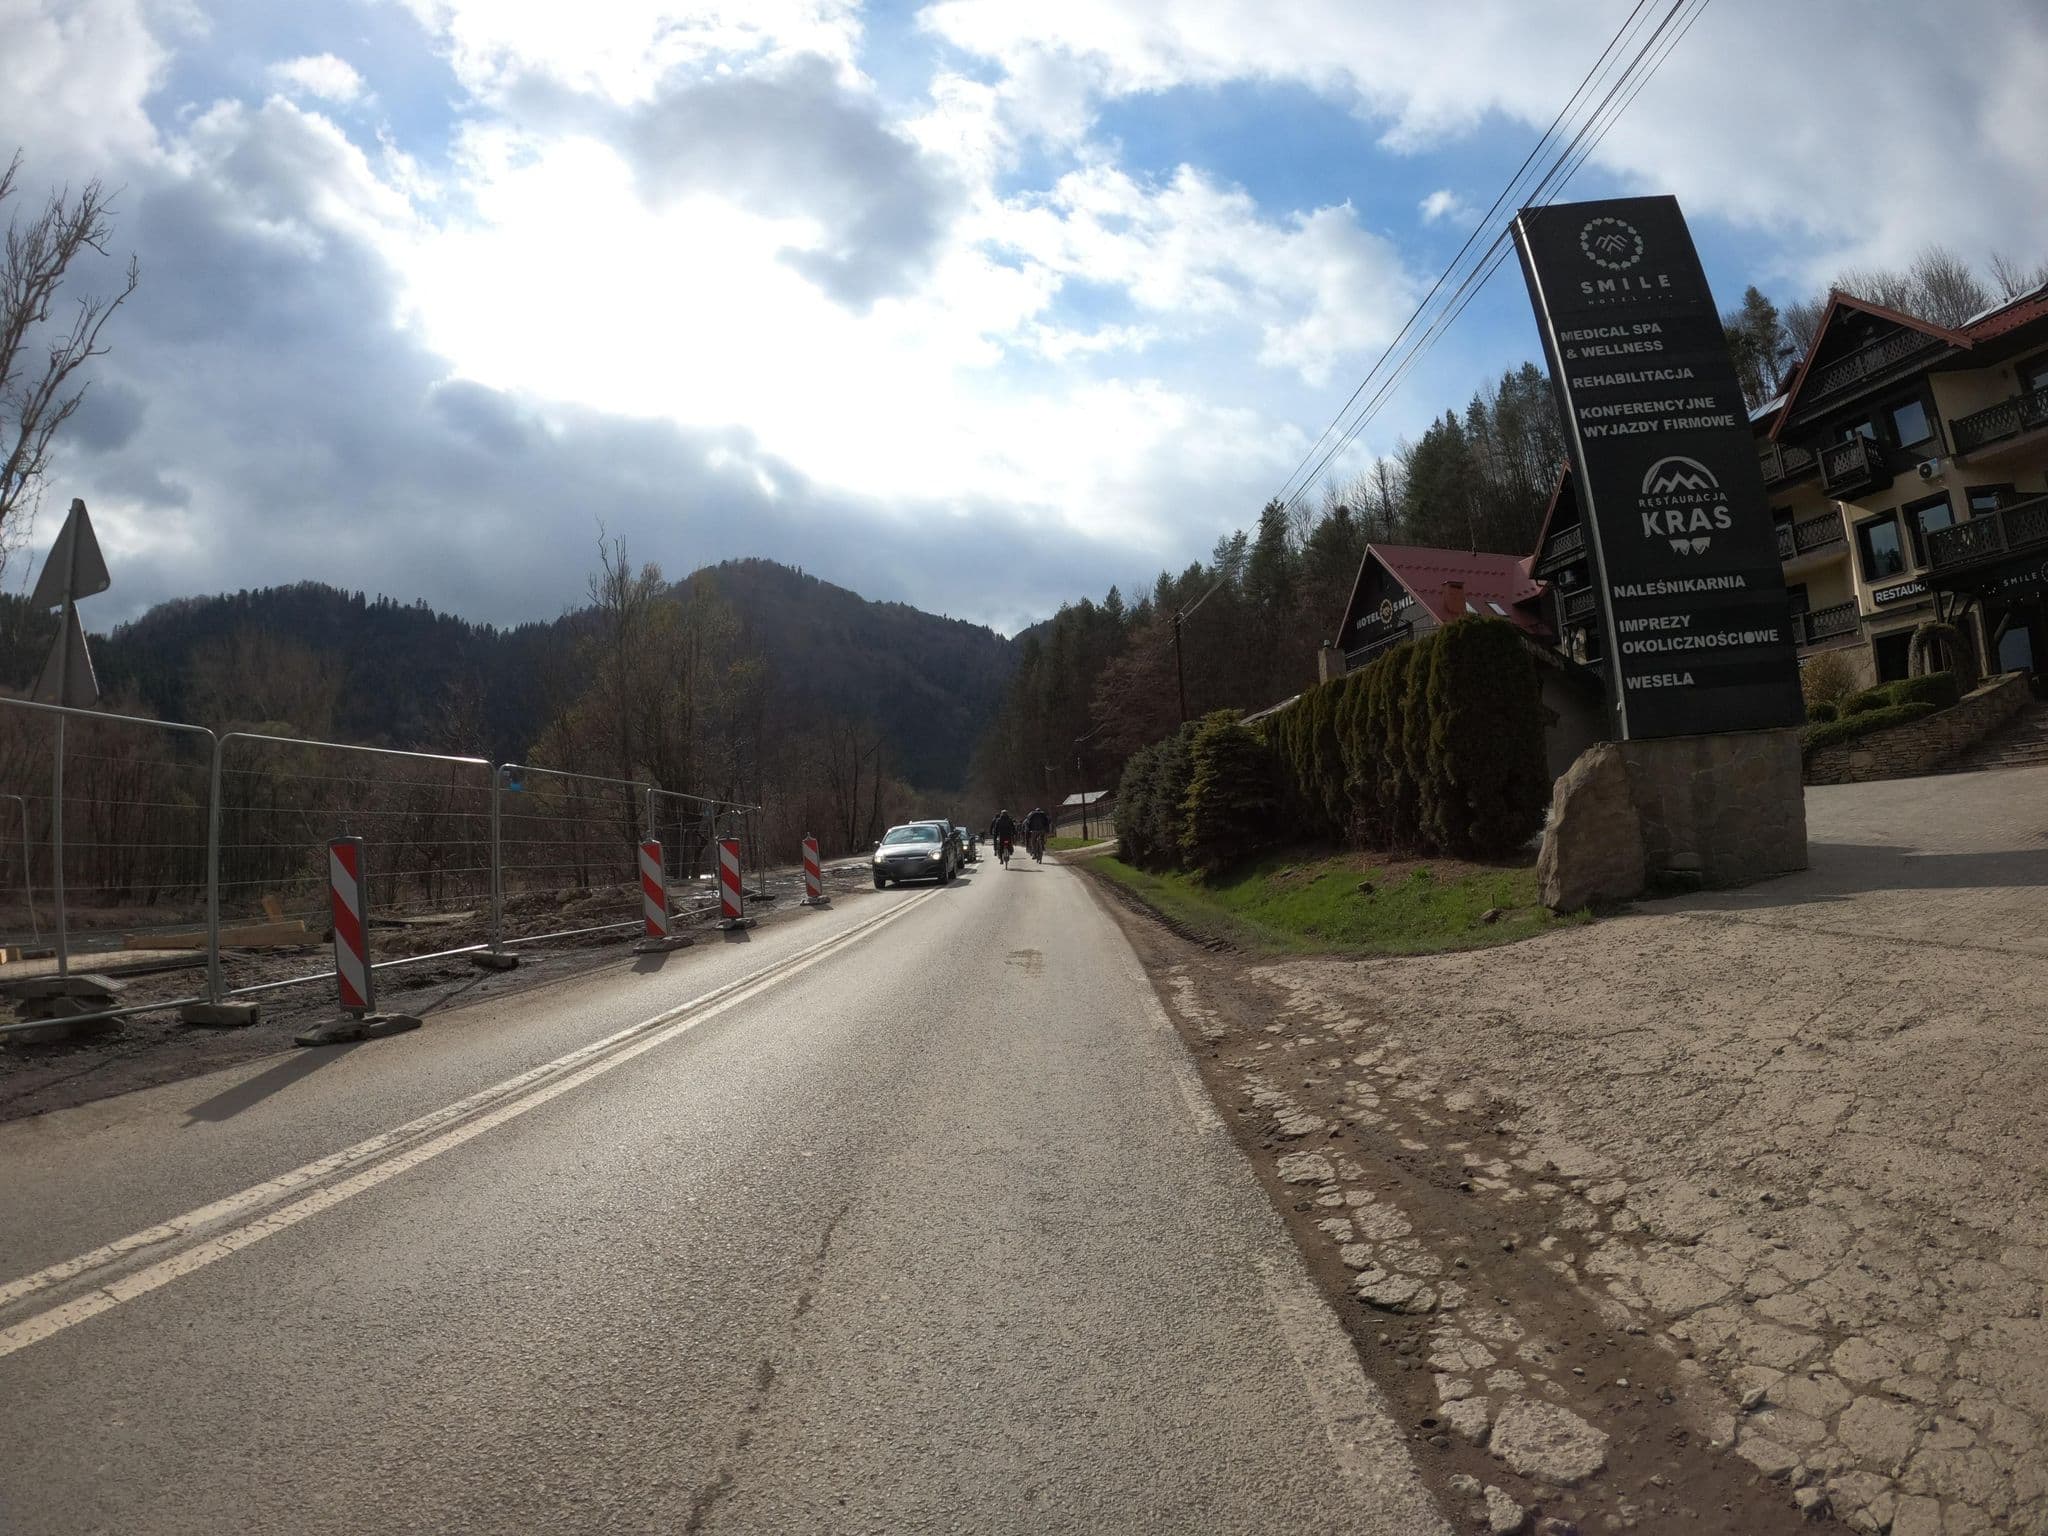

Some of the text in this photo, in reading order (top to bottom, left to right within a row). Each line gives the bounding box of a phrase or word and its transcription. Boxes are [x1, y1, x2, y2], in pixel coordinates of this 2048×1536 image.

[1580, 274, 1671, 294] SMILE
[1560, 323, 1663, 342] MEDICAL SPA
[1566, 340, 1664, 359] & WELLNESS
[1573, 367, 1694, 388] REHABILITACJA
[1580, 397, 1716, 419] KONFERENCYJNE
[1583, 415, 1735, 438] WYJAZDY FIRMOWE
[1638, 491, 1729, 508] RESTAURACJA
[1641, 505, 1732, 538] KRAS
[1613, 574, 1747, 598] NALEŚNIKARNIA
[2003, 572, 2038, 587] SMILE
[1875, 582, 1926, 603] RESTAUR
[1356, 595, 1415, 630] HOTEL SMIL
[1619, 615, 1691, 633] IMPREZY
[1622, 629, 1779, 654] OKOLICZNOŚCIOWE
[1626, 672, 1695, 690] WESELA
